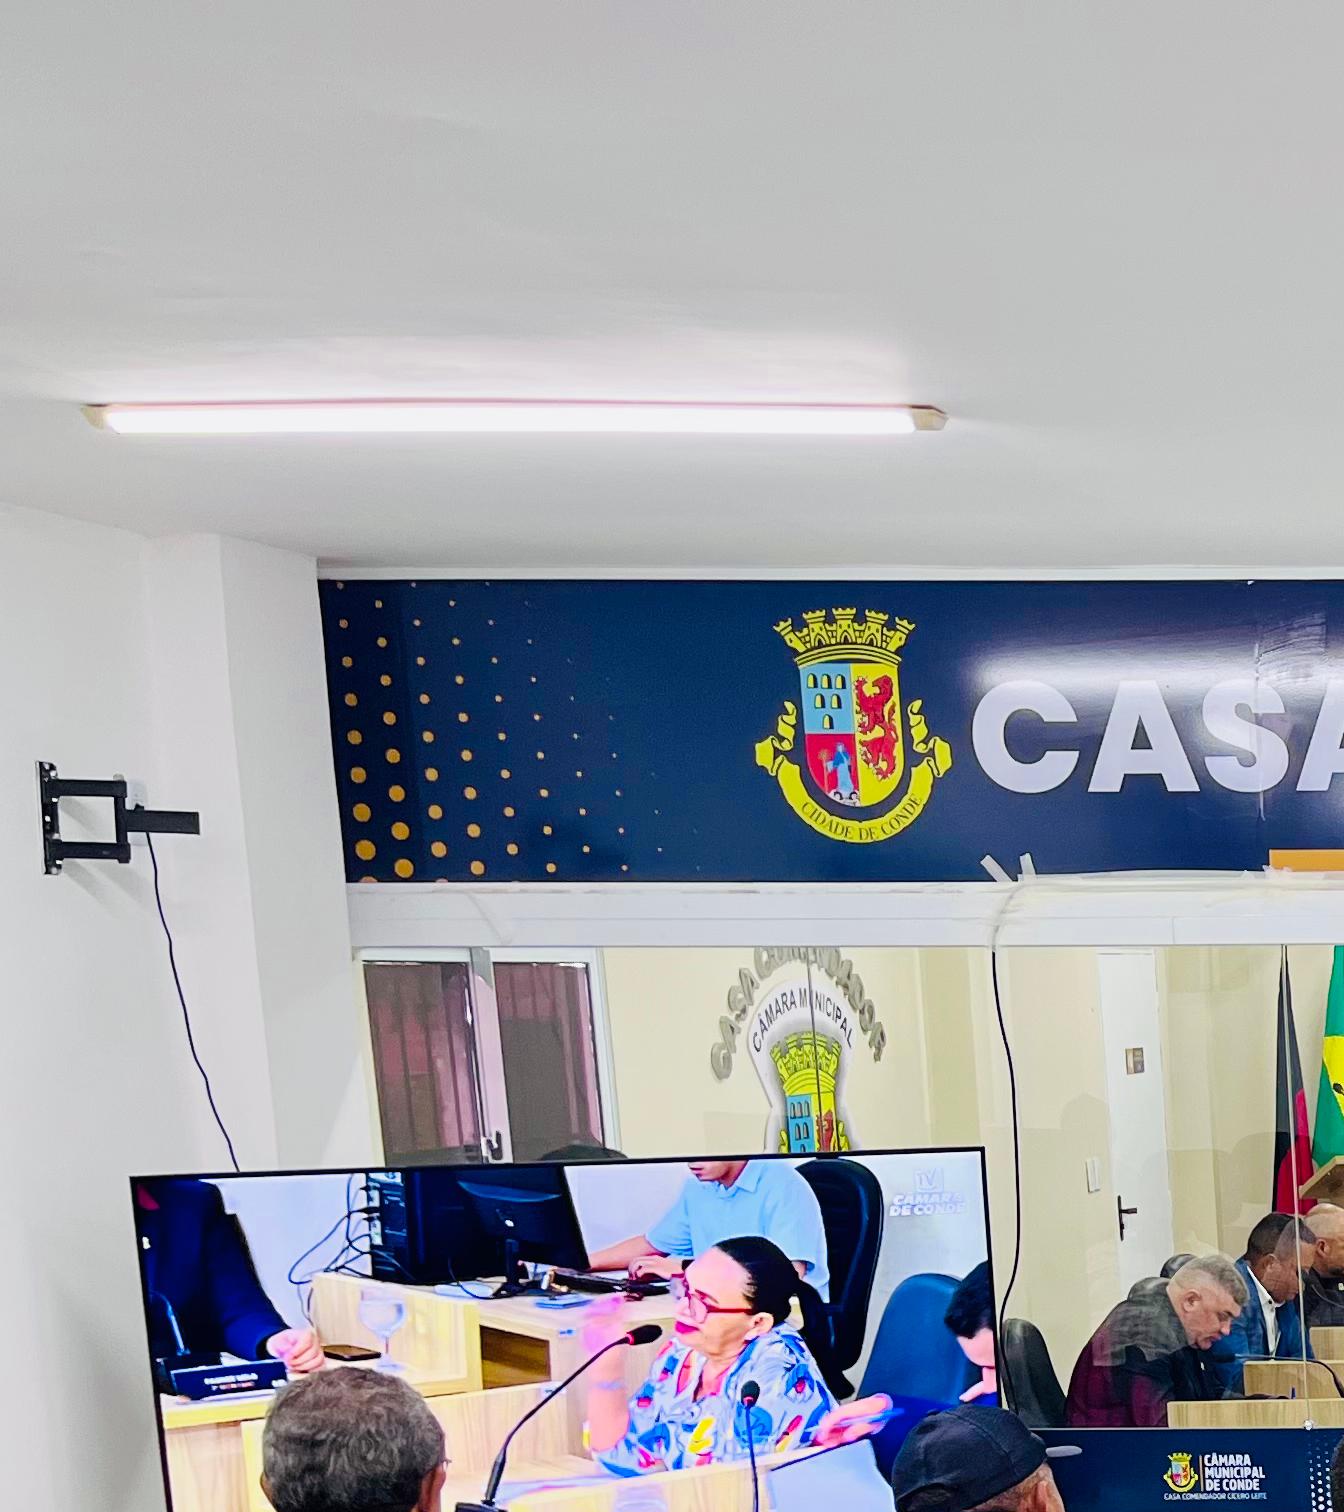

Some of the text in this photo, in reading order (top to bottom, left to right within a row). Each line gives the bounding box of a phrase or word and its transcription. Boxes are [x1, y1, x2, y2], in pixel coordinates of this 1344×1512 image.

[801, 793, 923, 841] CIDADE DE CONDE
[710, 967, 761, 1081] CASA
[753, 987, 853, 1053] CÂMARA MNICIPAL
[1204, 1452, 1252, 1467] CÂMARA
[1204, 1466, 1266, 1479] MUNICIPAL
[1205, 1478, 1260, 1492] DE CONDE
